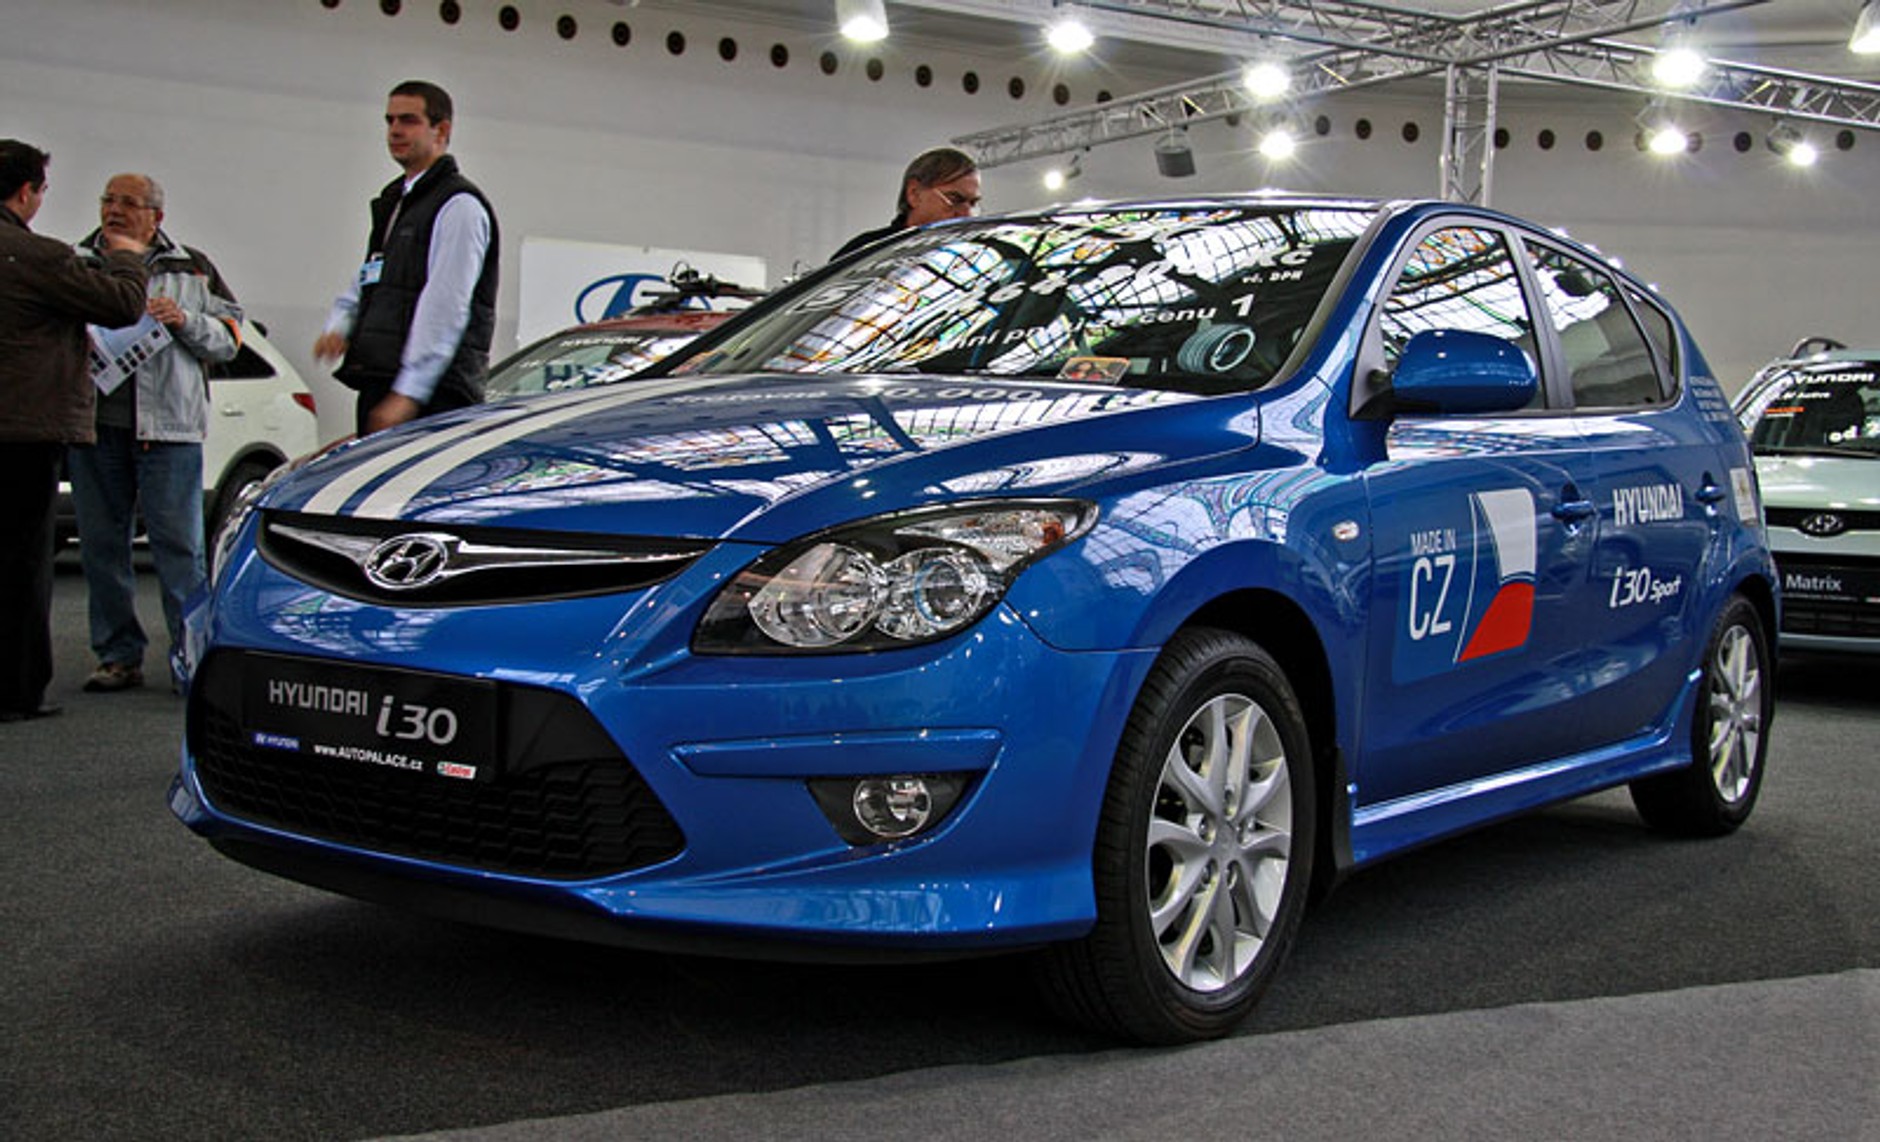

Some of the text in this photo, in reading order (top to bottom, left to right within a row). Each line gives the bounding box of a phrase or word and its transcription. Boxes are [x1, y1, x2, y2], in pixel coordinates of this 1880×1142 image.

[1612, 483, 1684, 527] HYUNDAI
[1410, 528, 1456, 556] MADE IN
[1409, 554, 1456, 641] CZ
[1609, 566, 1682, 608] i30 Sport
[1785, 573, 1842, 591] Matrix
[269, 679, 458, 745] HYUNDAI i30
[313, 743, 423, 772] www.AUTOPALACE.cz
